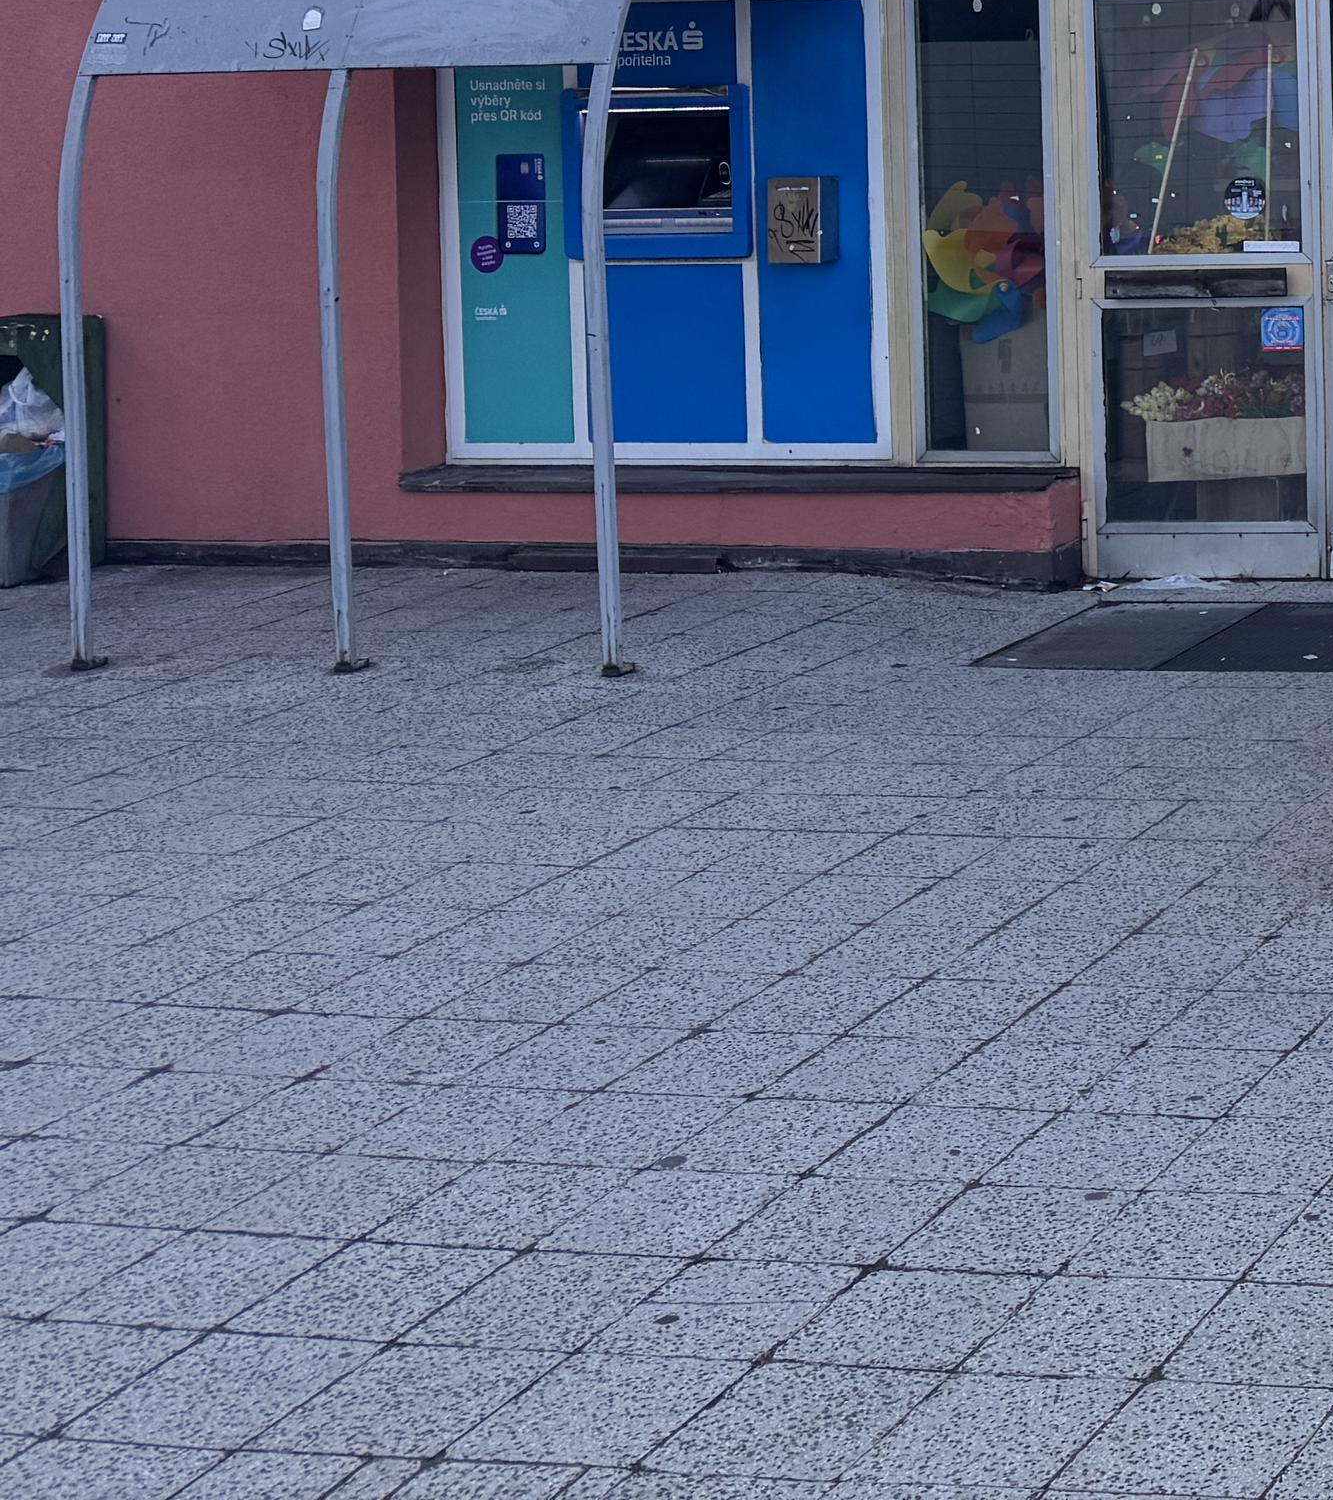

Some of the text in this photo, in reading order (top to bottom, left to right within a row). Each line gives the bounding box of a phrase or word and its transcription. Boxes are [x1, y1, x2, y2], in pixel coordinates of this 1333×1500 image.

[619, 25, 679, 51] ESKÁ
[617, 53, 672, 68] pořitelna
[470, 78, 545, 91] Usnadněte si
[470, 94, 511, 109] výběry
[470, 109, 542, 125] přes QR kód
